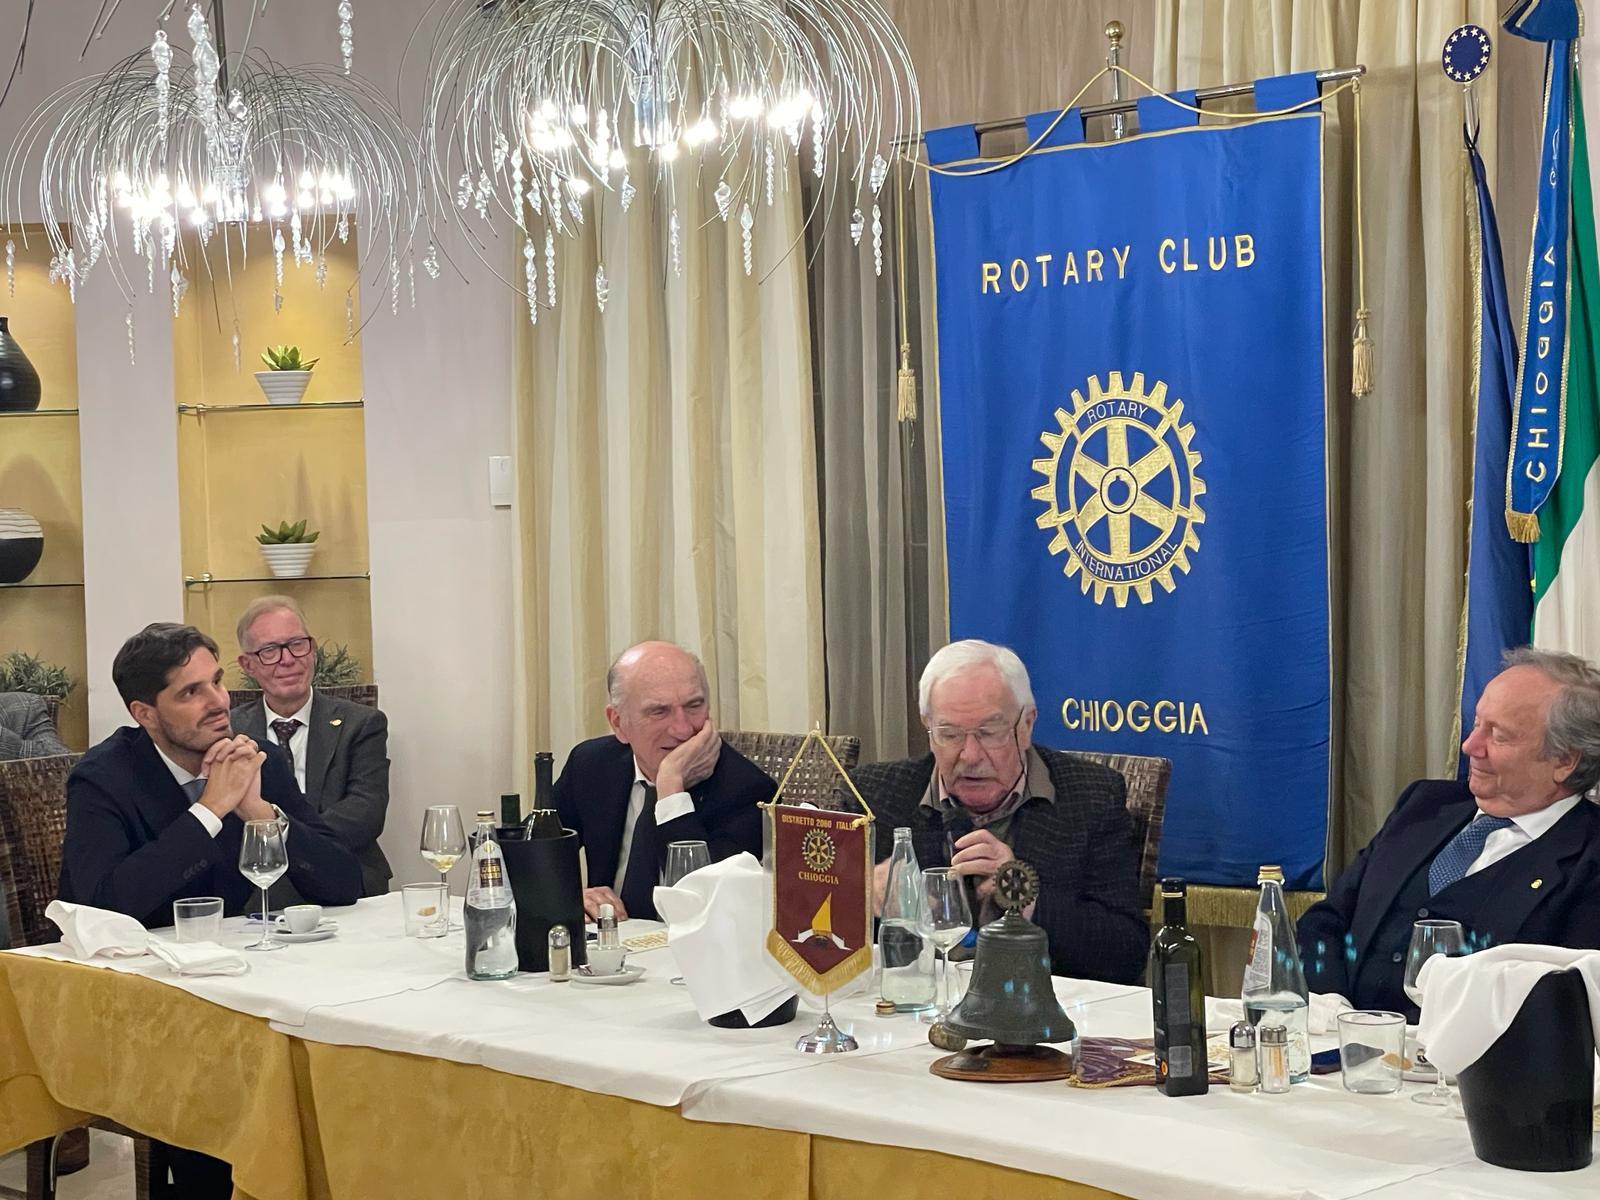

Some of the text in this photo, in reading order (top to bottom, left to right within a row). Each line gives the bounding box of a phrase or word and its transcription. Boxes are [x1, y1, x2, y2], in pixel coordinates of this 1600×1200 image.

[981, 233, 1256, 294] ROTARY CLUB
[1525, 246, 1557, 482] CHIOGGIA
[1085, 400, 1149, 424] ROTARY
[1075, 539, 1178, 581] INTERNATIONAL
[1061, 697, 1209, 735] CHIOGGIA
[781, 814, 815, 826] DISTRETTO
[836, 821, 857, 831] ITALI
[798, 871, 839, 885] CHIOGGIA
